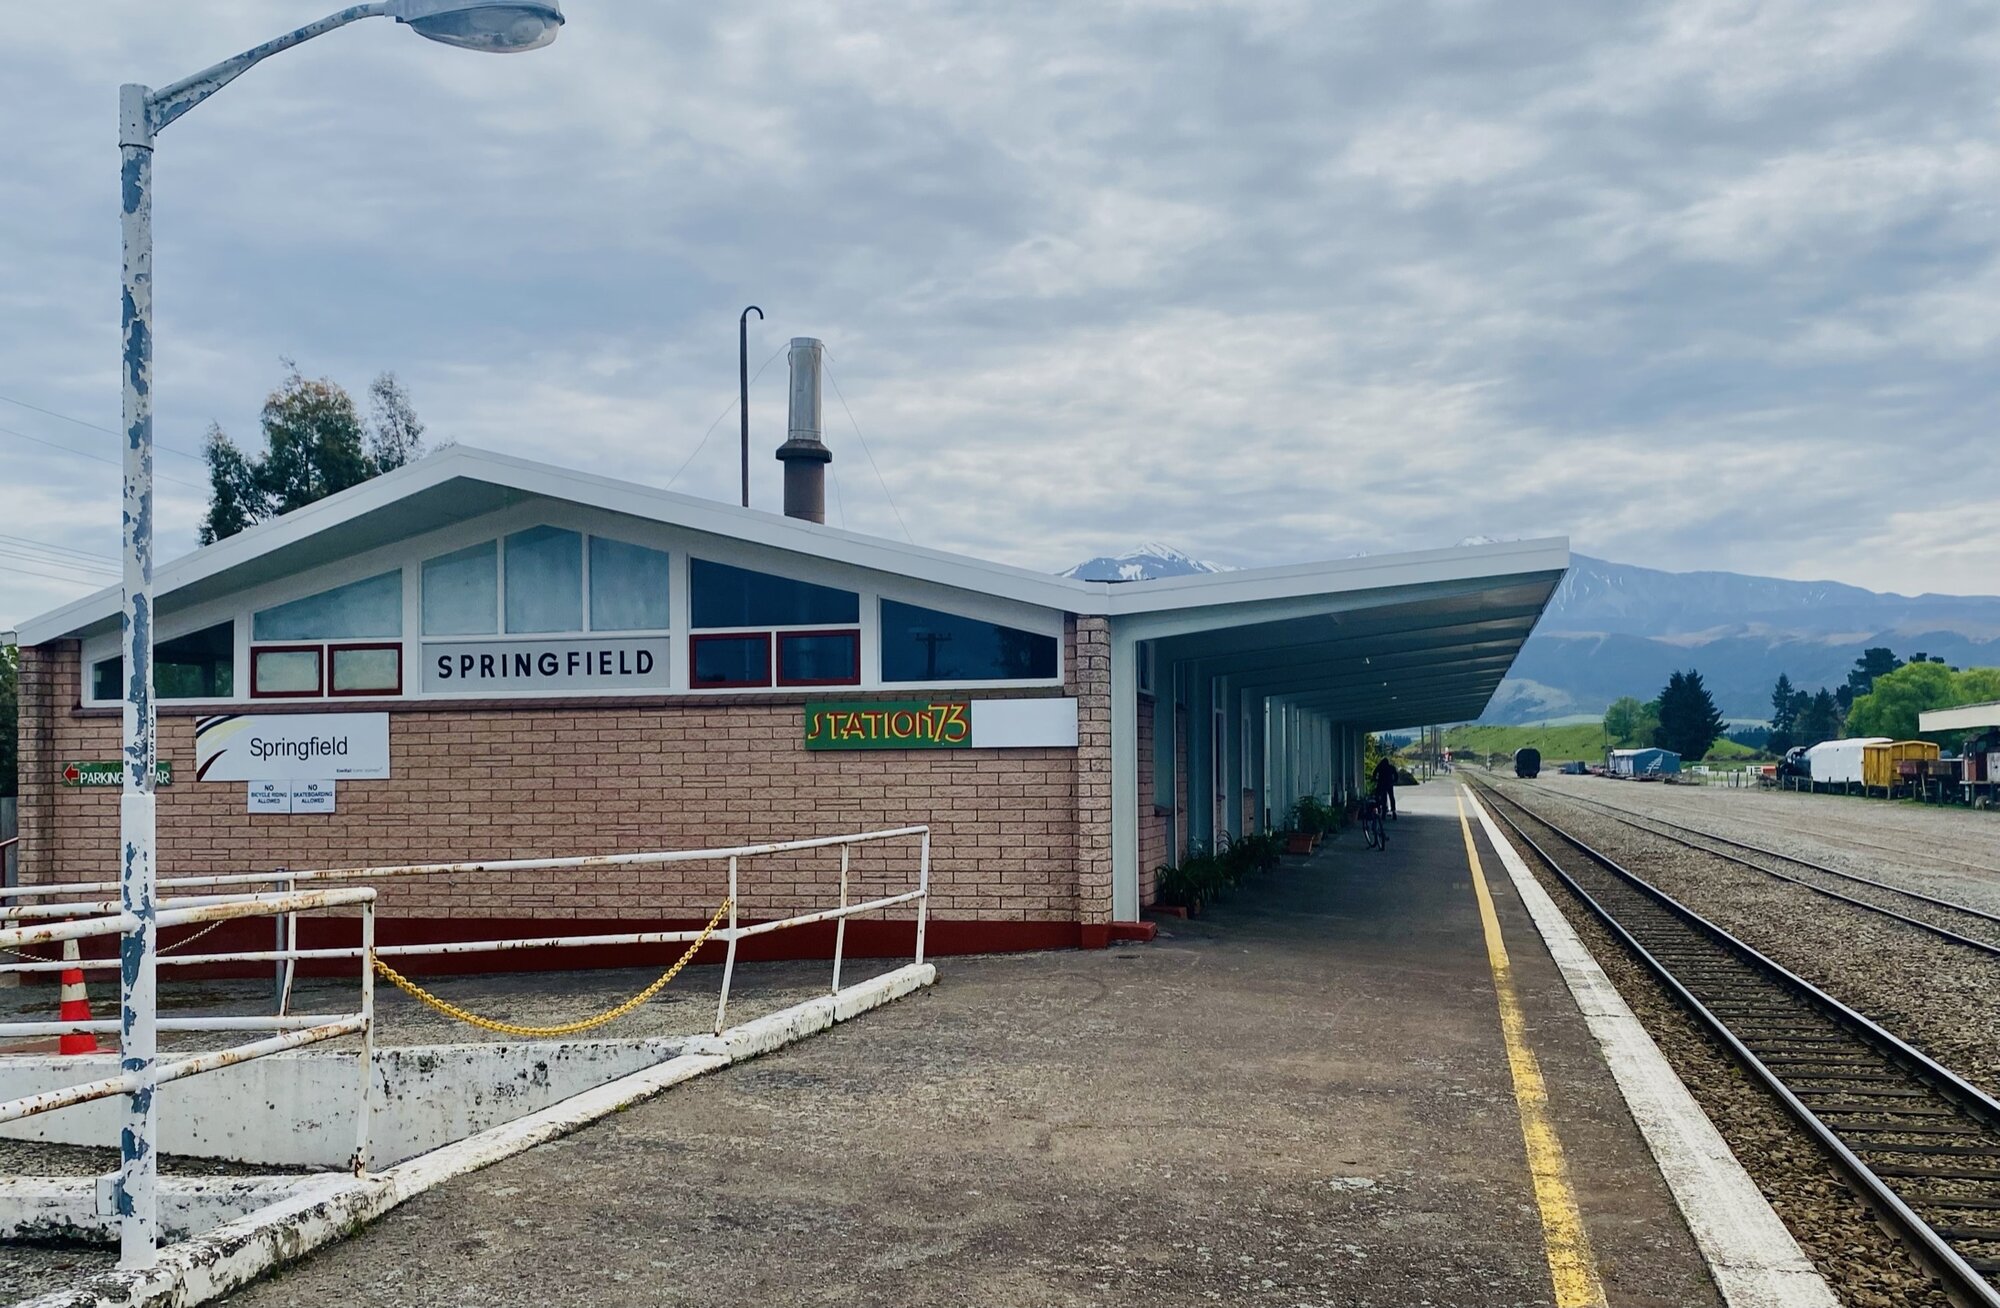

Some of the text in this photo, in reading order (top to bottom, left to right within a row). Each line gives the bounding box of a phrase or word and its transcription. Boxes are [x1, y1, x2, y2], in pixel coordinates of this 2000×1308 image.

[437, 650, 654, 679] SPRINGFIELD
[250, 736, 348, 761] Springfield
[80, 772, 123, 784] PARKING
